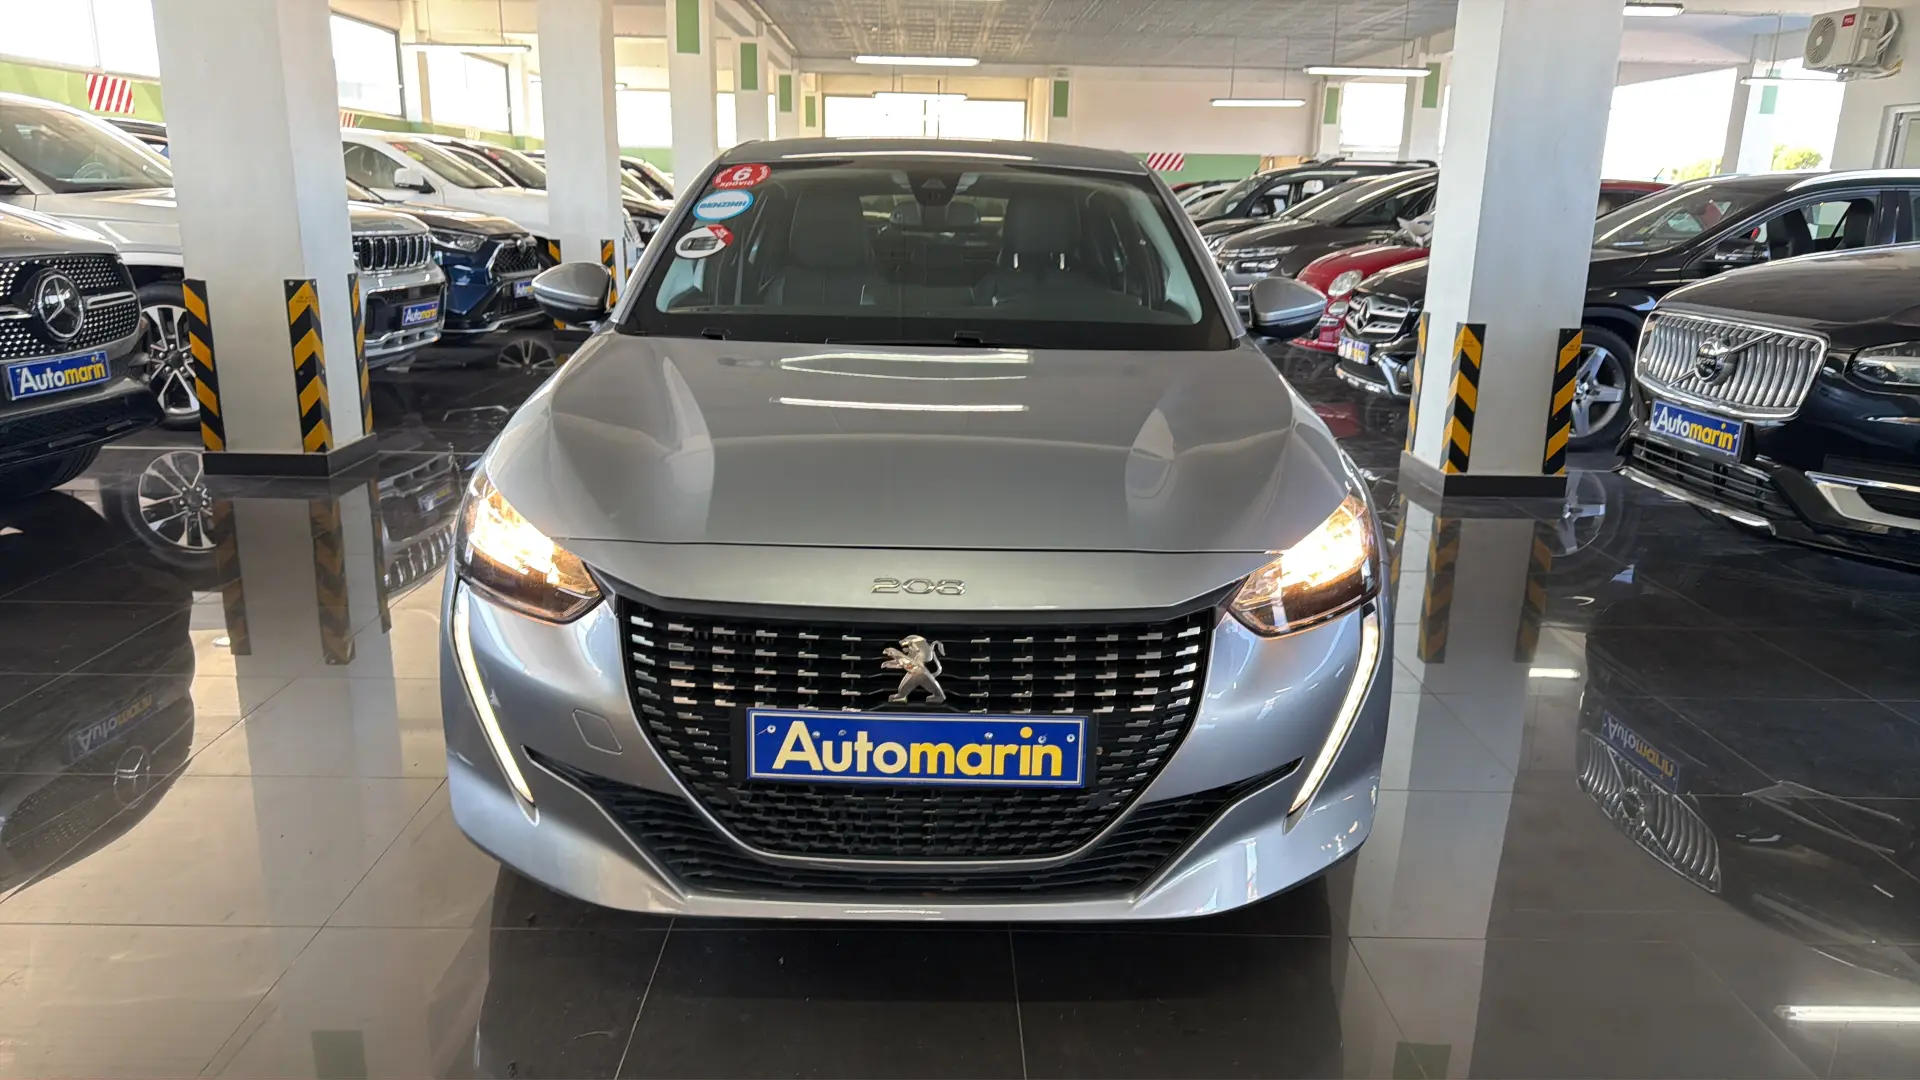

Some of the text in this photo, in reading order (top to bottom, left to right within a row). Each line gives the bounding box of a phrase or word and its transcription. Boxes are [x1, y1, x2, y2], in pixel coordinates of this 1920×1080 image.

[733, 166, 754, 182] 6
[20, 355, 106, 394] Automarin
[1655, 406, 1734, 450] Automarin
[871, 577, 966, 596] 208
[771, 720, 1063, 776] Automarin
